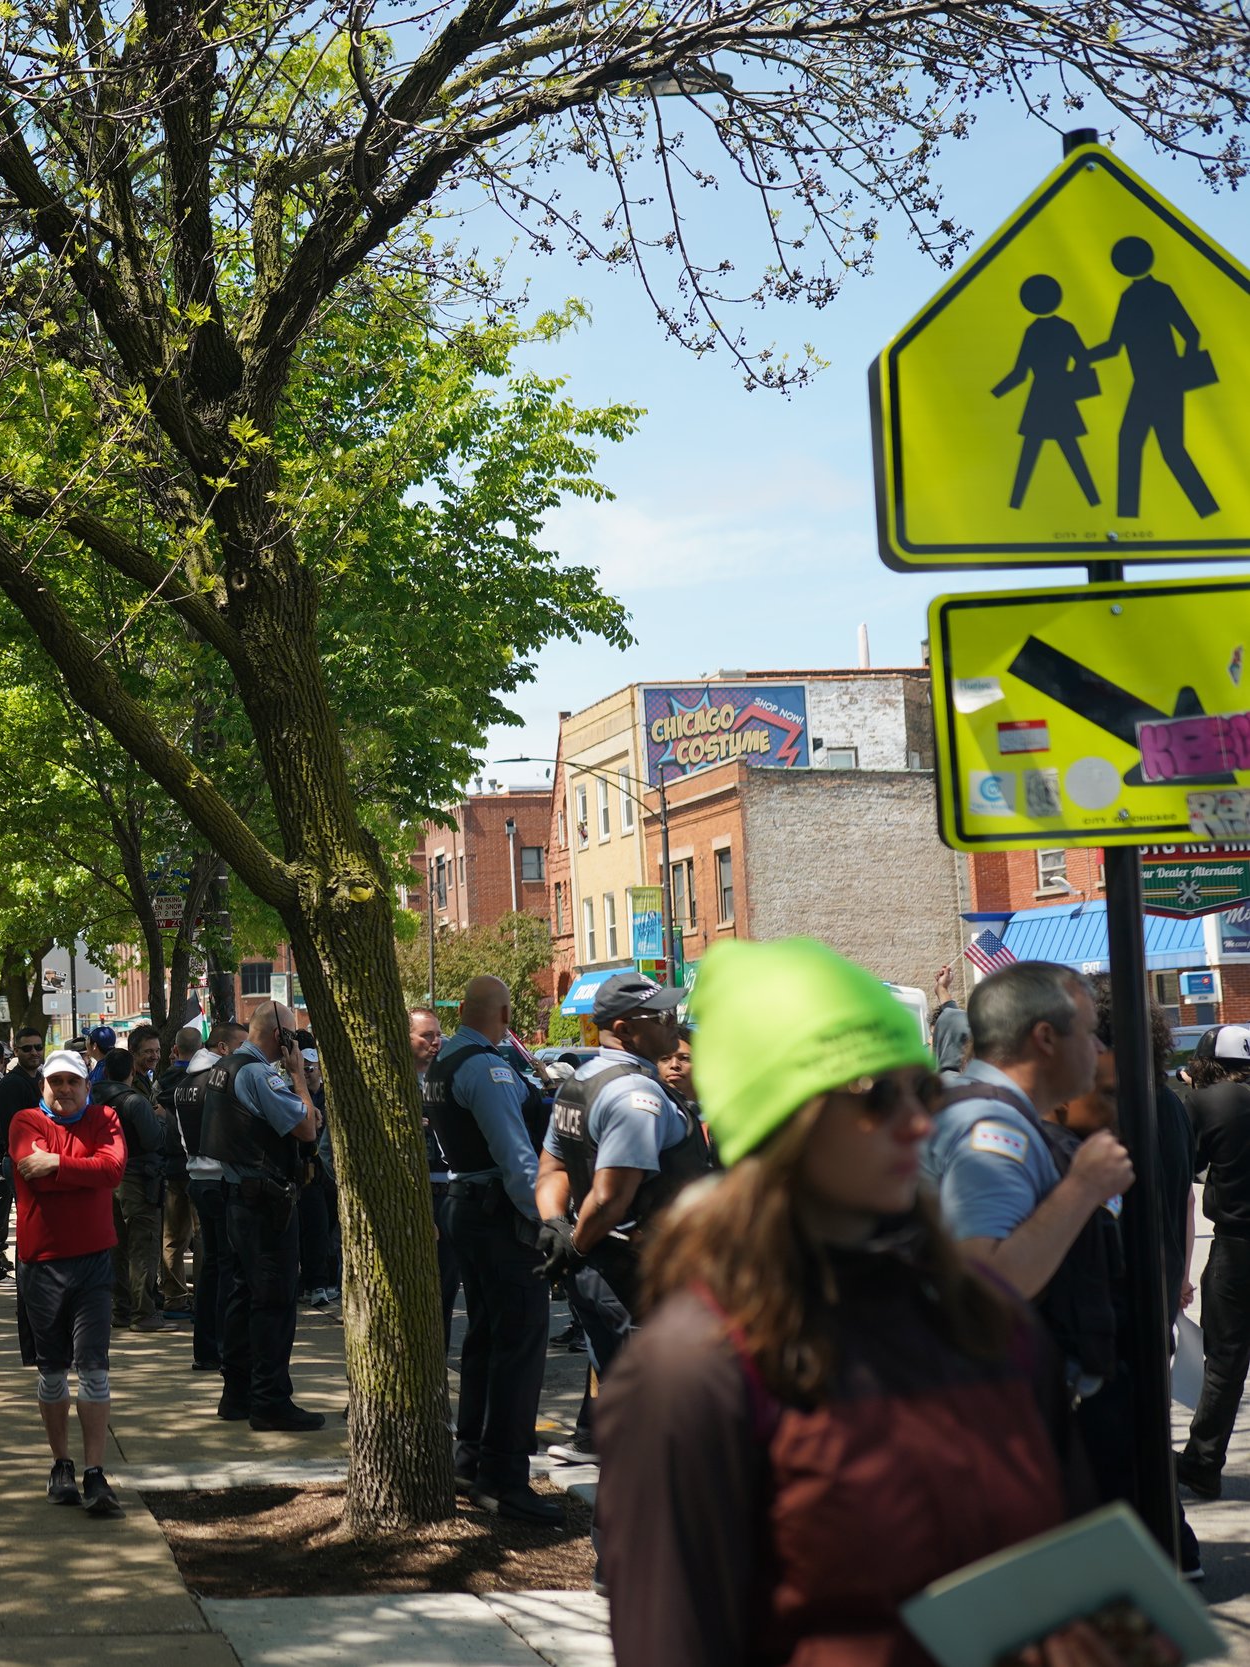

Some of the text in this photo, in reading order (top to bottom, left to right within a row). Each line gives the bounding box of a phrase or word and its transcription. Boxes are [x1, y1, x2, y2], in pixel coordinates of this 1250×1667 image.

[651, 703, 735, 743] CHICAGO
[753, 697, 805, 725] SHOP NOW!
[676, 729, 771, 766] COSTUME
[1140, 865, 1245, 879] our Dealer Alternative
[1082, 961, 1101, 974] EXIT
[176, 1087, 199, 1102] POLICE
[554, 1103, 581, 1136] POLICE
